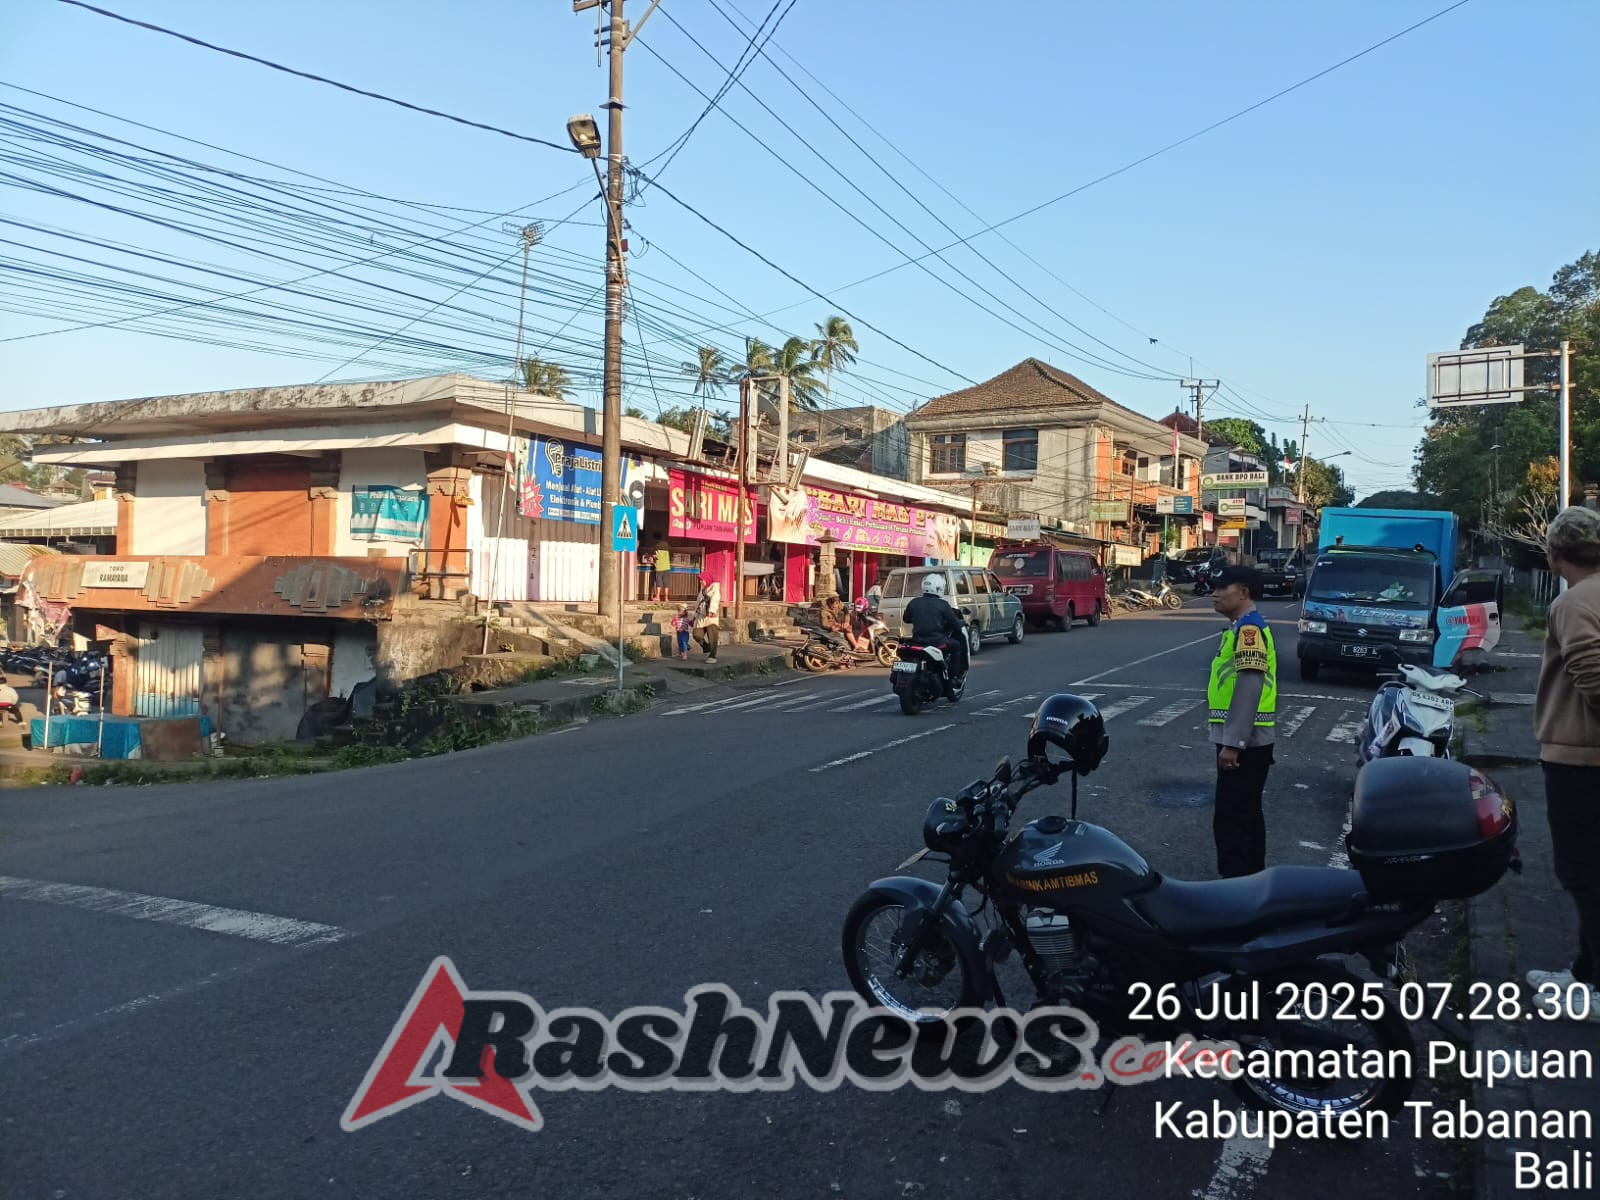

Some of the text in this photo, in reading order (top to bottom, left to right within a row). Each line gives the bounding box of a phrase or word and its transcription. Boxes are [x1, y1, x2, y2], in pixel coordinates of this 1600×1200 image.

[555, 452, 602, 472] PrajaListri
[1217, 471, 1265, 481] BANK BPD BALI
[586, 499, 601, 509] Plumb
[672, 486, 713, 521] SARI
[1033, 859, 1064, 868] HONDA
